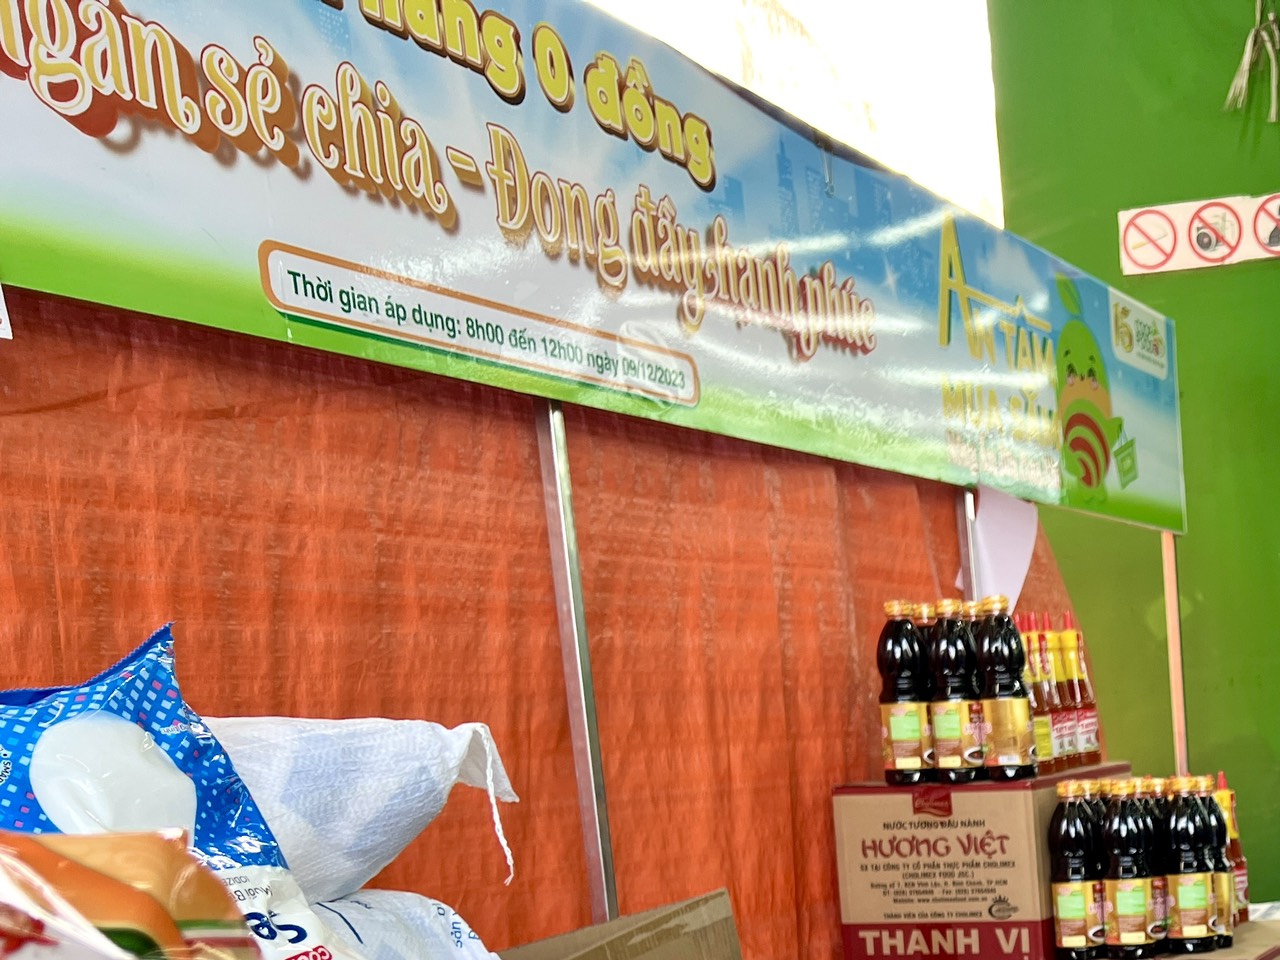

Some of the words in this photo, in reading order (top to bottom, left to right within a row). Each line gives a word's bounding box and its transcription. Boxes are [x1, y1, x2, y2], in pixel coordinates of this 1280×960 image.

[200, 37, 286, 152] sẻ
[303, 62, 448, 213] chia
[486, 122, 627, 286] Đong
[533, 24, 571, 105] 0
[585, 53, 714, 188] đồng
[287, 269, 334, 304] Thời
[339, 289, 379, 320] gian
[385, 296, 407, 325] áp
[413, 304, 461, 338] dụng:
[465, 316, 504, 346] 8h00
[509, 329, 537, 354] đến
[540, 334, 582, 364] 12h00
[585, 350, 619, 378] ngày
[621, 356, 686, 390] 09/12/2023
[956, 829, 1010, 859] VIỆT
[859, 928, 980, 956] THANH
[995, 928, 1030, 960] VỊ
